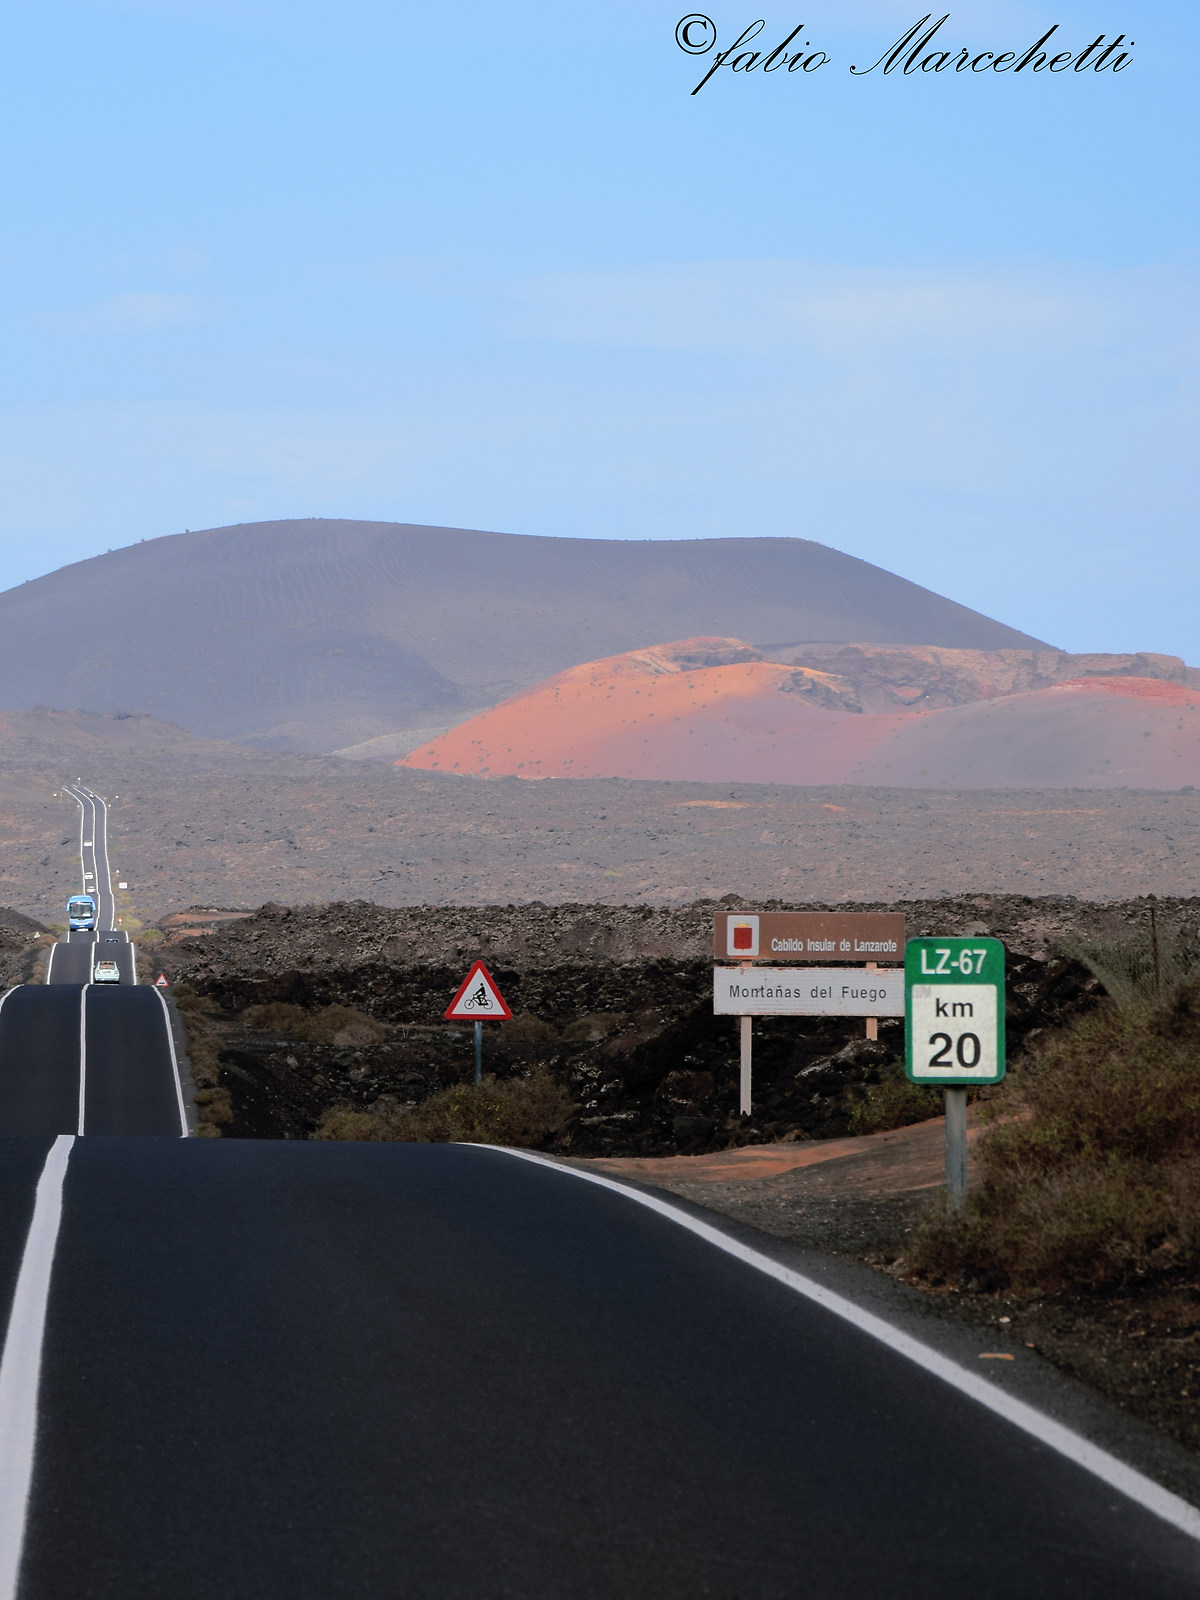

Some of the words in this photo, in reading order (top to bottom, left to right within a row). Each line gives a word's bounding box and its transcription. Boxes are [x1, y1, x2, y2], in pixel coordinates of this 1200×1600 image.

[771, 938, 804, 952] Cabildo
[807, 938, 836, 952] Insular
[840, 939, 851, 952] de
[854, 939, 897, 952] Lanzarote
[921, 949, 987, 975] LZ-67
[729, 985, 801, 998] Montañas
[810, 986, 832, 999] del
[841, 986, 887, 1002] Fuego
[935, 998, 974, 1018] km
[928, 1032, 981, 1068] 20
